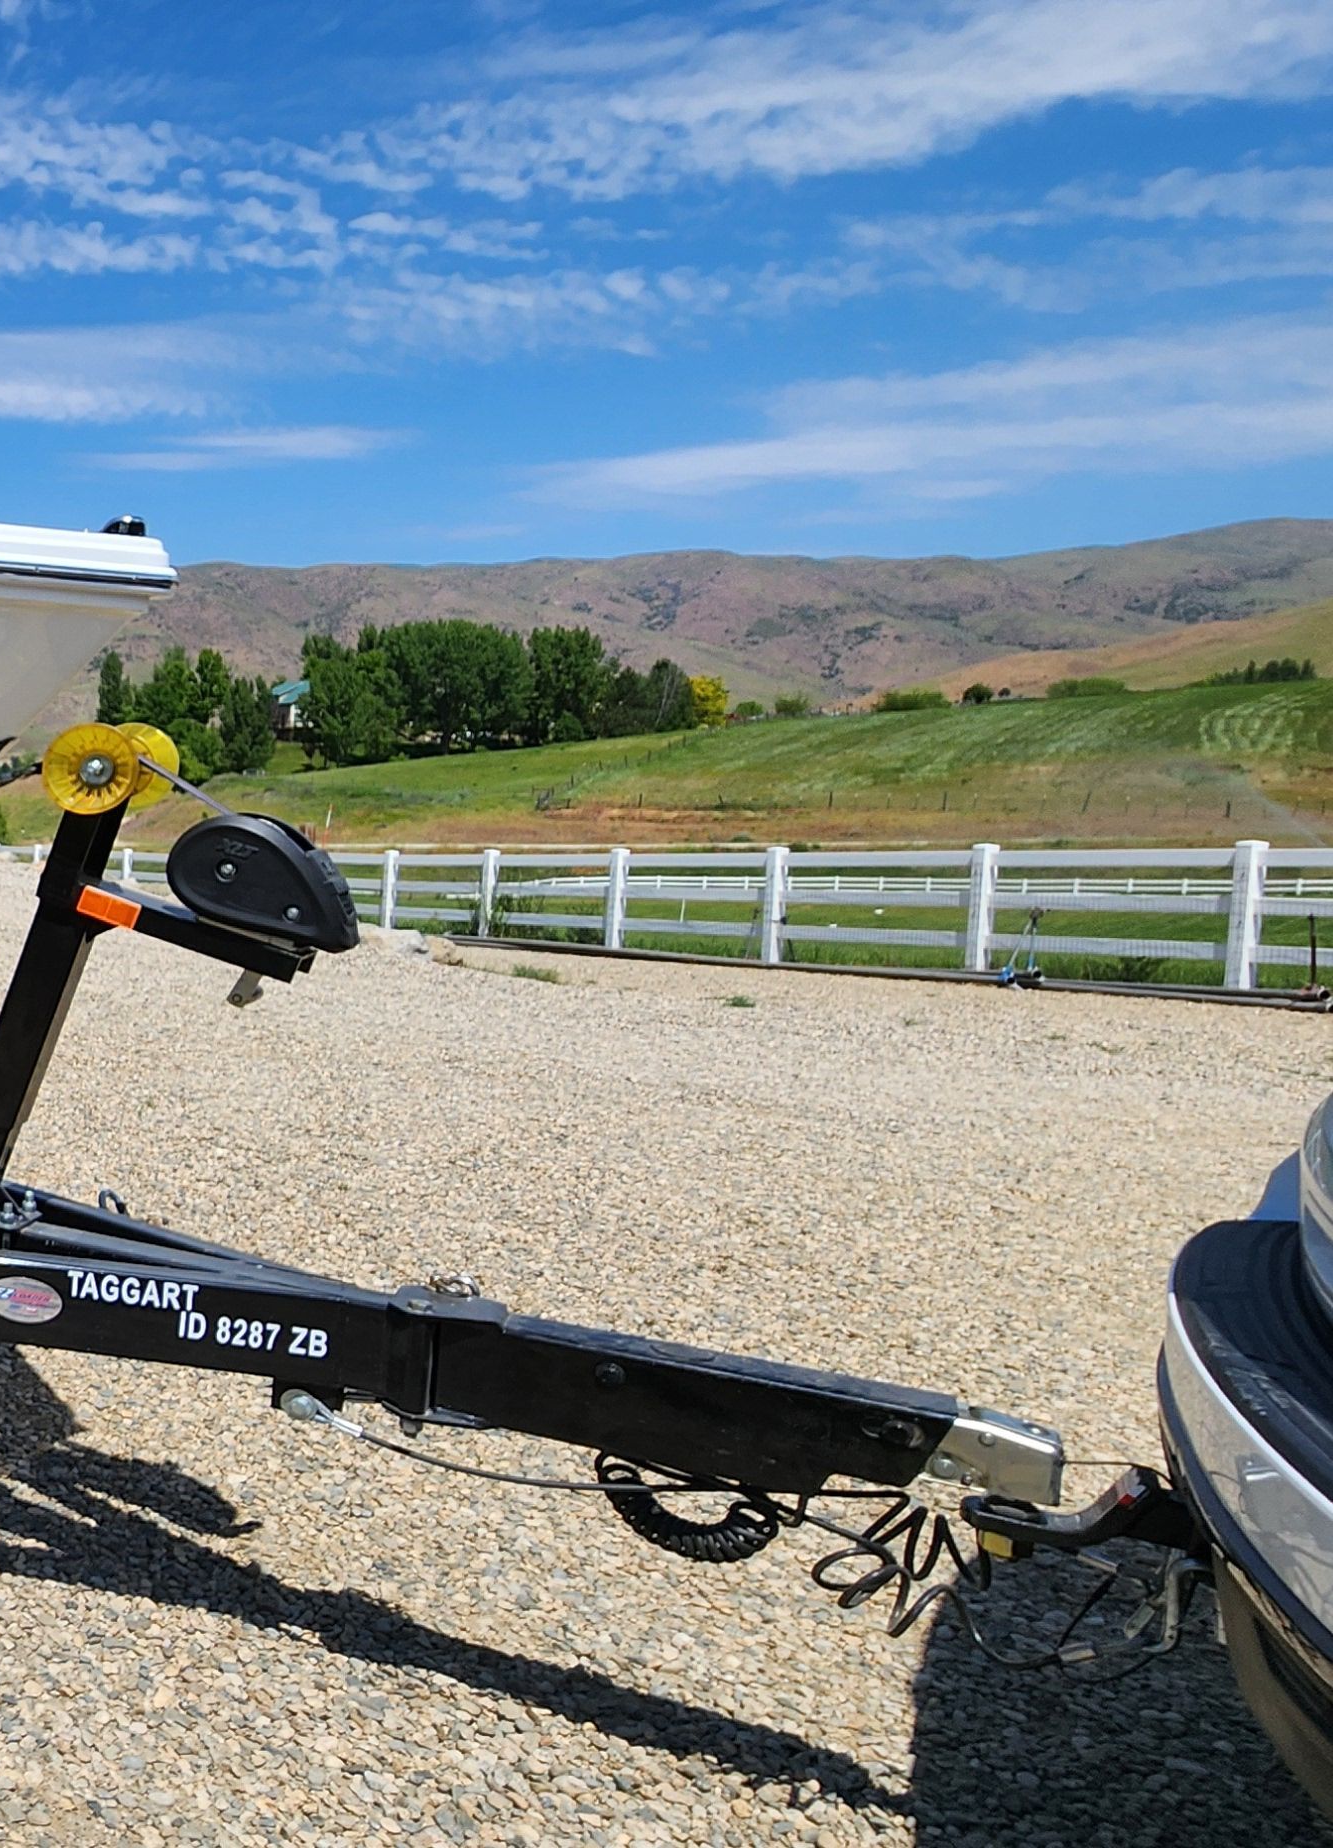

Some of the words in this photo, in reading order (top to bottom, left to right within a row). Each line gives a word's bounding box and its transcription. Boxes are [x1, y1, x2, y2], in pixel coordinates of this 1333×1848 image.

[67, 1270, 199, 1311] TAGGART
[178, 1311, 207, 1340] ID
[216, 1316, 281, 1351] 8287
[288, 1326, 329, 1358] ZB
